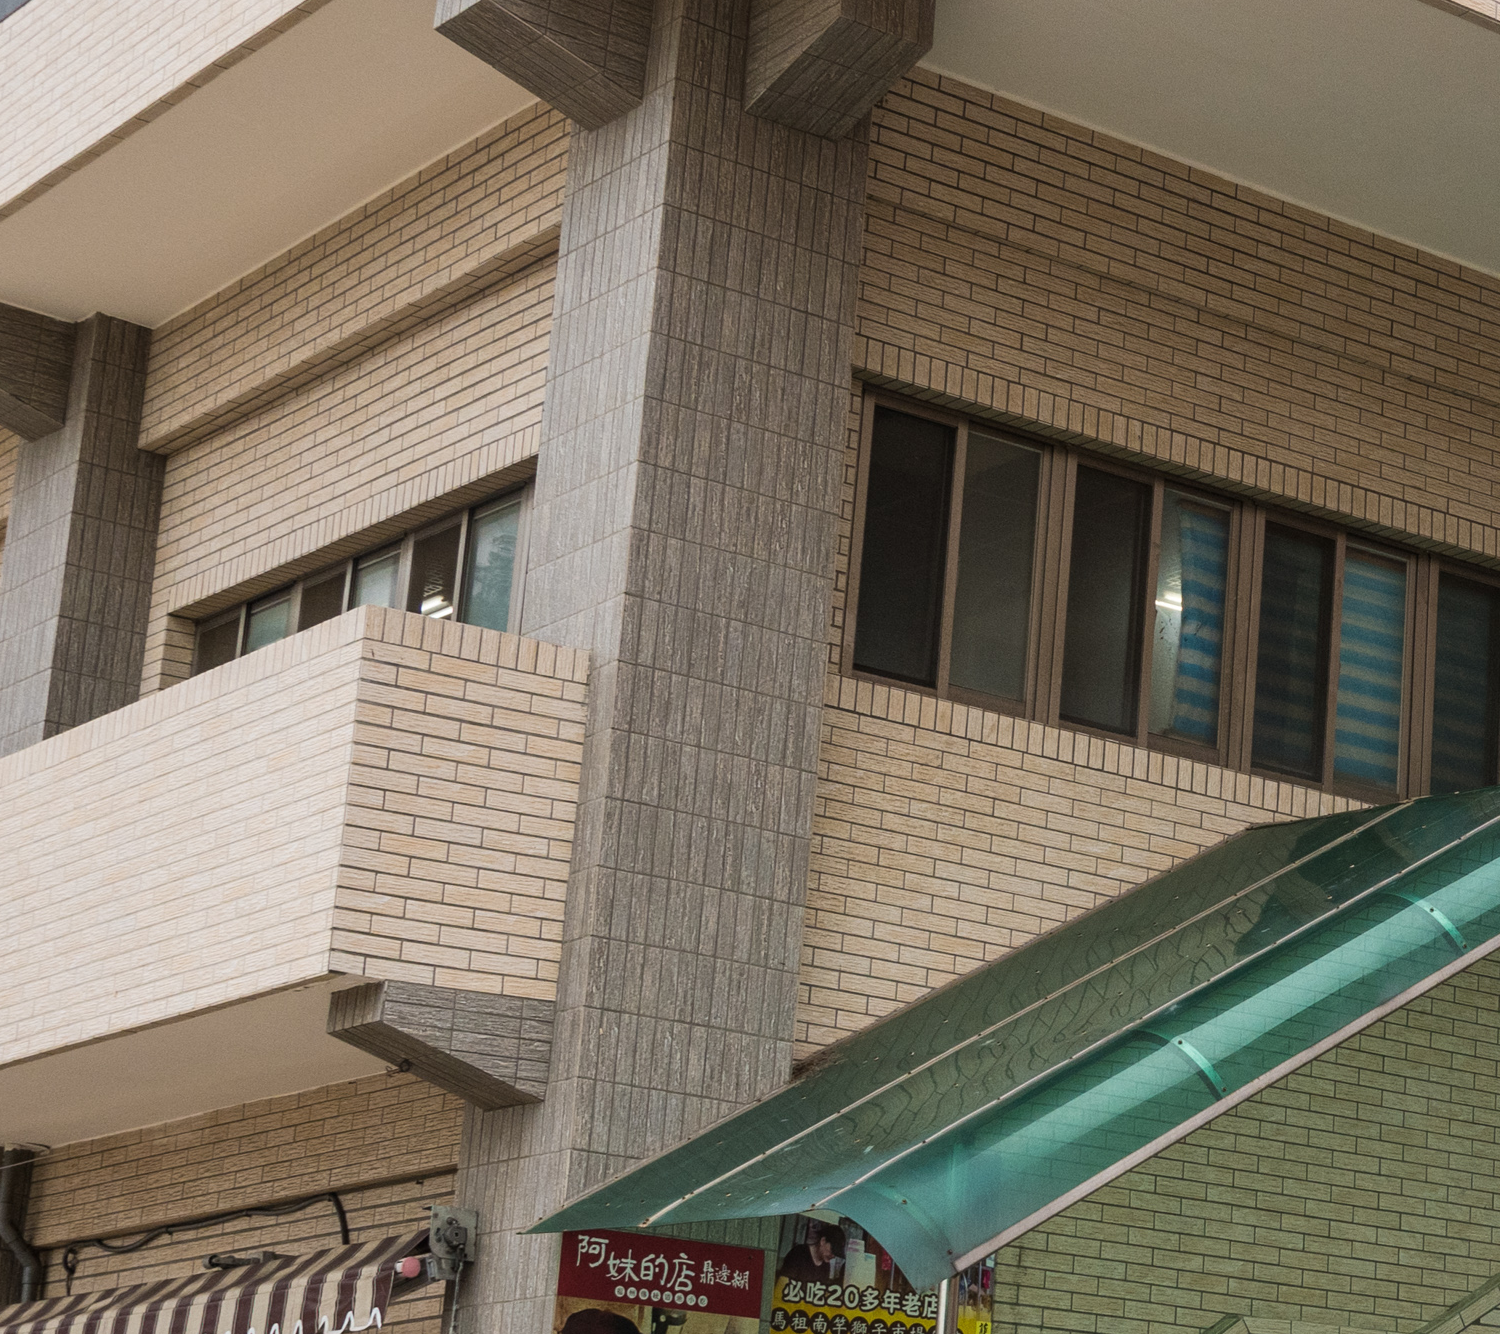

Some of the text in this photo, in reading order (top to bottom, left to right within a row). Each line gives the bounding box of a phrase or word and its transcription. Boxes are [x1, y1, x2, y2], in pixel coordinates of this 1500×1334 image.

[576, 1234, 750, 1292] 阿妹的店 鼎邊糊
[783, 1279, 938, 1319] 必吃20多年老店
